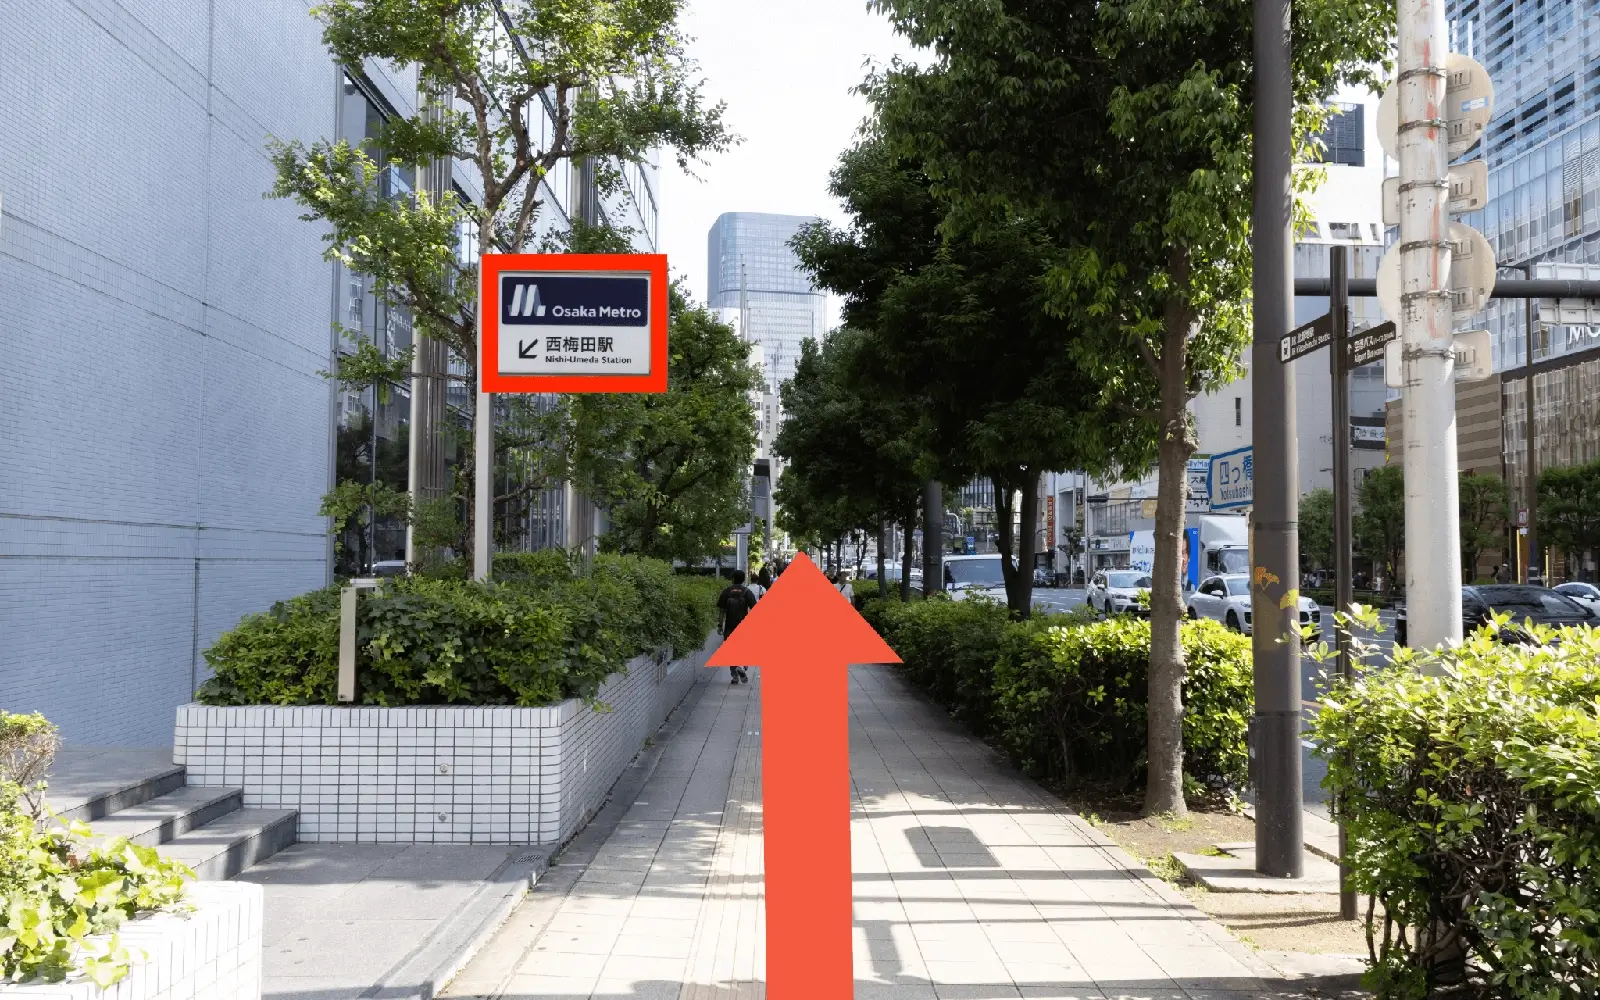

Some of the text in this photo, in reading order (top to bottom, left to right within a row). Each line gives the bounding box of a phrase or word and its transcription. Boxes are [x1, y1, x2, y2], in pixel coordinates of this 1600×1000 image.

[552, 305, 641, 318] Osaka Metro
[545, 336, 614, 353] 西梅田駅
[545, 355, 632, 364] Nishi-Umeda Station
